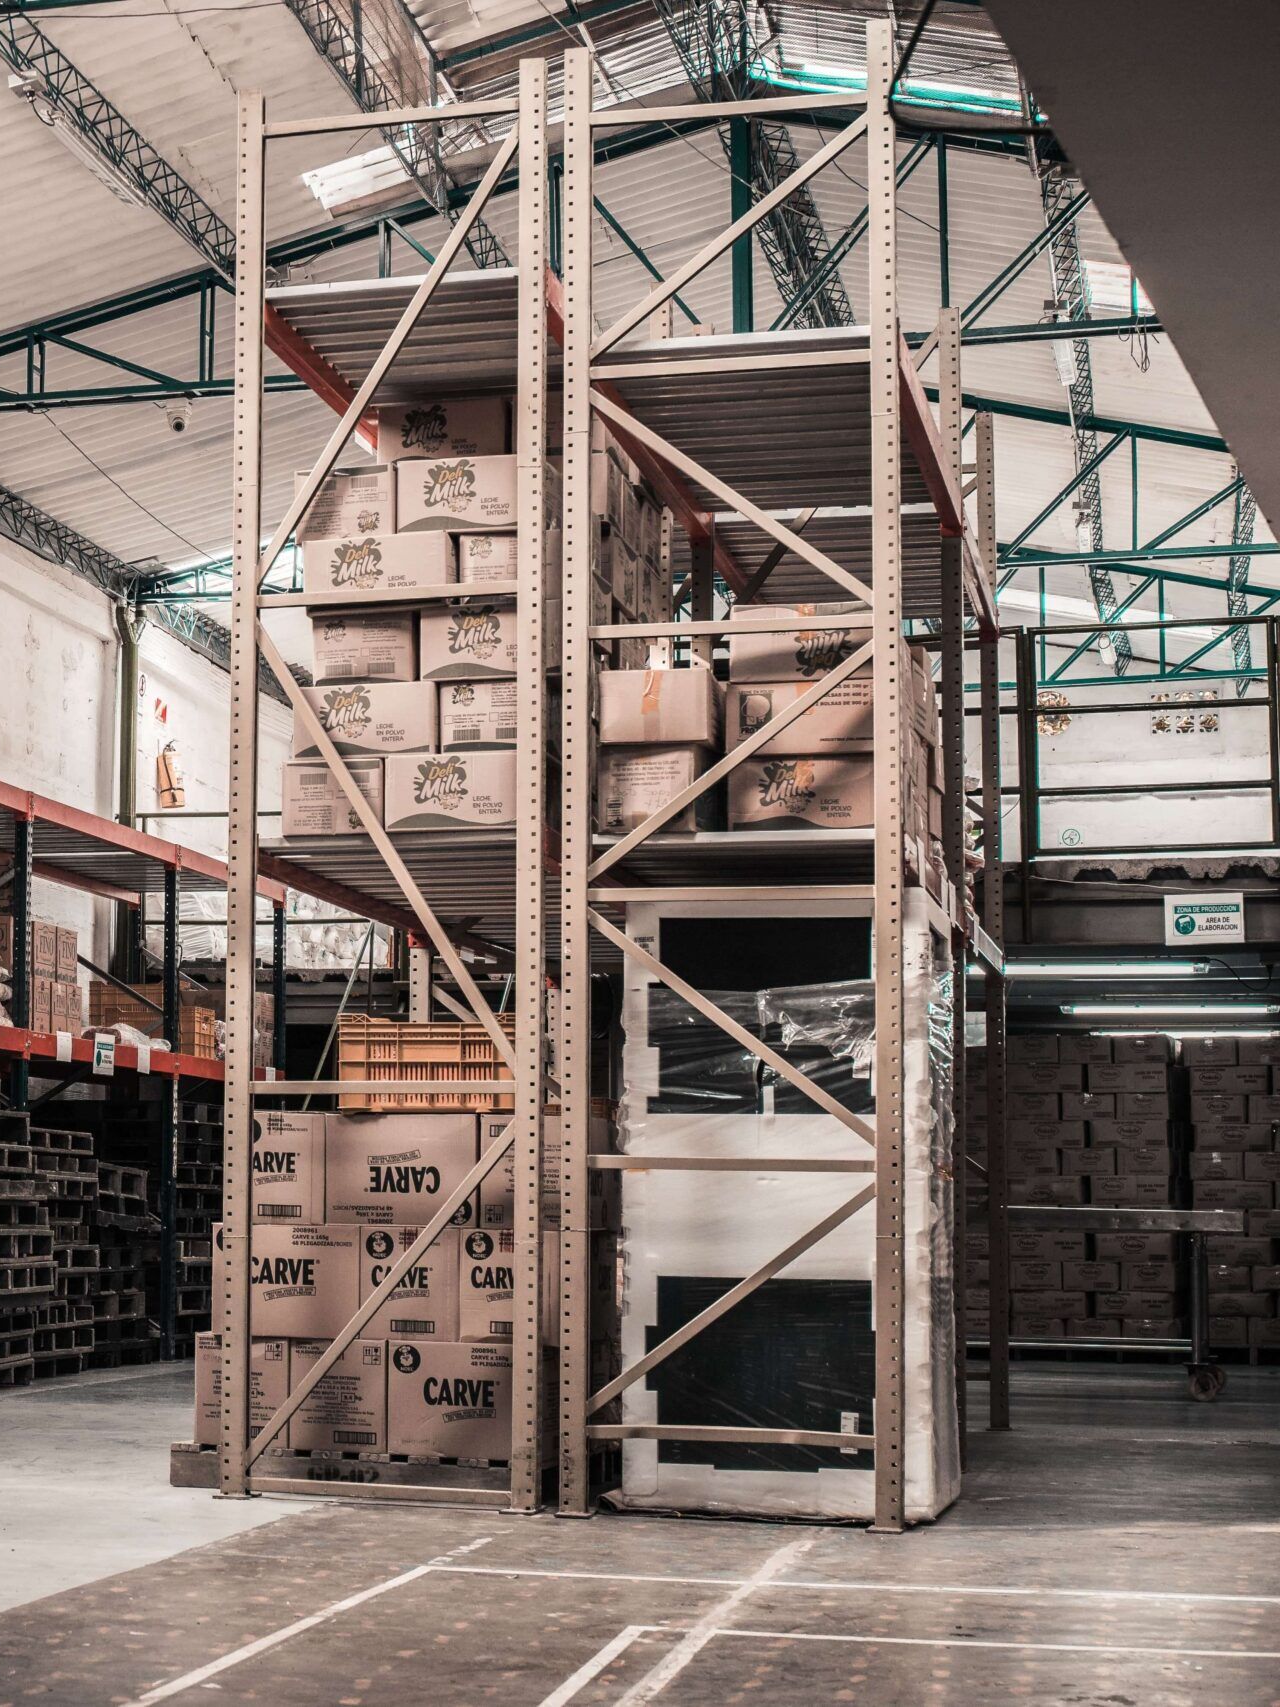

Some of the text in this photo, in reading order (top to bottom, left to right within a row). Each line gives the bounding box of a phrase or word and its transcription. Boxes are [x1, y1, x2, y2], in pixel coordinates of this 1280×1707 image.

[407, 418, 446, 443] Milk
[439, 464, 464, 484] Deli
[431, 481, 472, 503] Milk
[346, 541, 371, 563] Deli
[338, 560, 379, 582] Milk
[464, 614, 486, 630] Deli
[455, 626, 497, 649] Milk
[335, 690, 358, 709] Deli
[326, 706, 367, 729] Milk
[428, 763, 454, 780] Deli
[421, 777, 463, 801] Milk
[252, 1151, 296, 1174] ARVE
[370, 1166, 441, 1194] CARVE
[423, 1376, 495, 1408] CARVE
